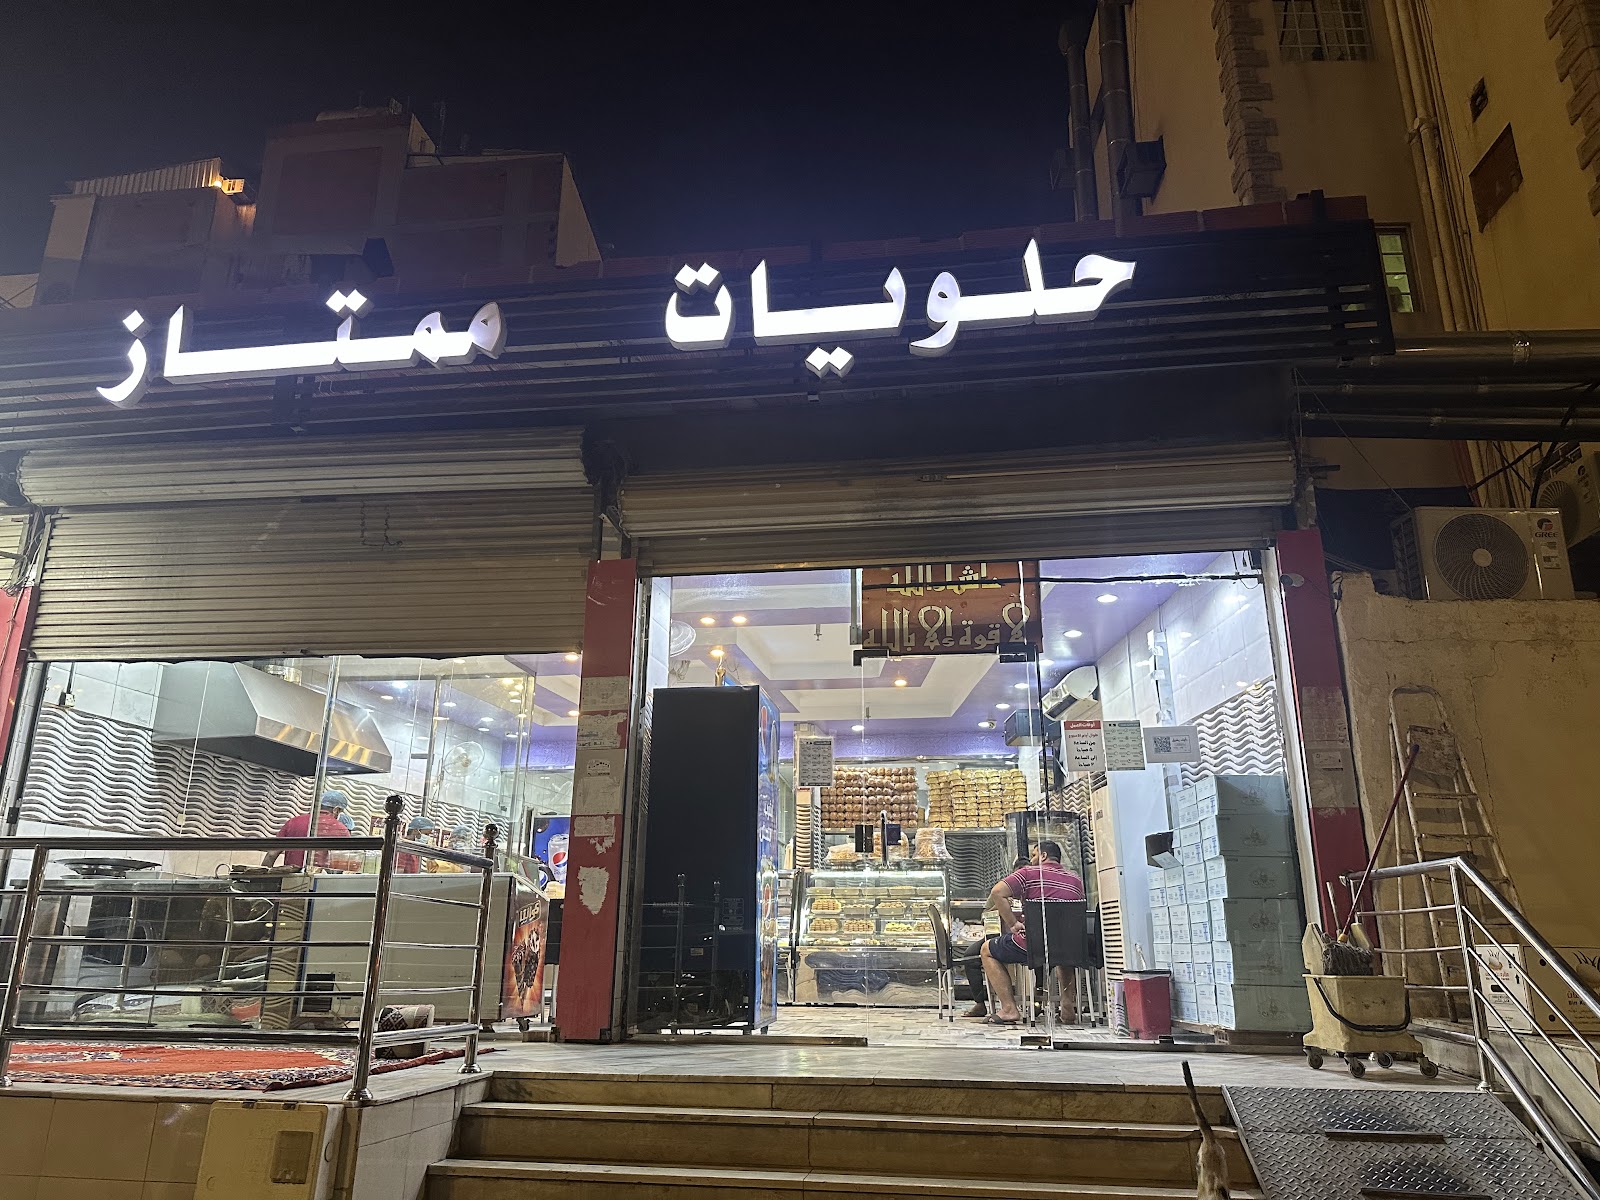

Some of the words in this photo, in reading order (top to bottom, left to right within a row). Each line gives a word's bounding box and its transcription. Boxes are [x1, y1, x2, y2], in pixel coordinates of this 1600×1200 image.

[665, 238, 1136, 375] حلويات
[97, 289, 505, 406] ممتاز
[863, 606, 916, 652] بالله
[958, 619, 1001, 650] قوة
